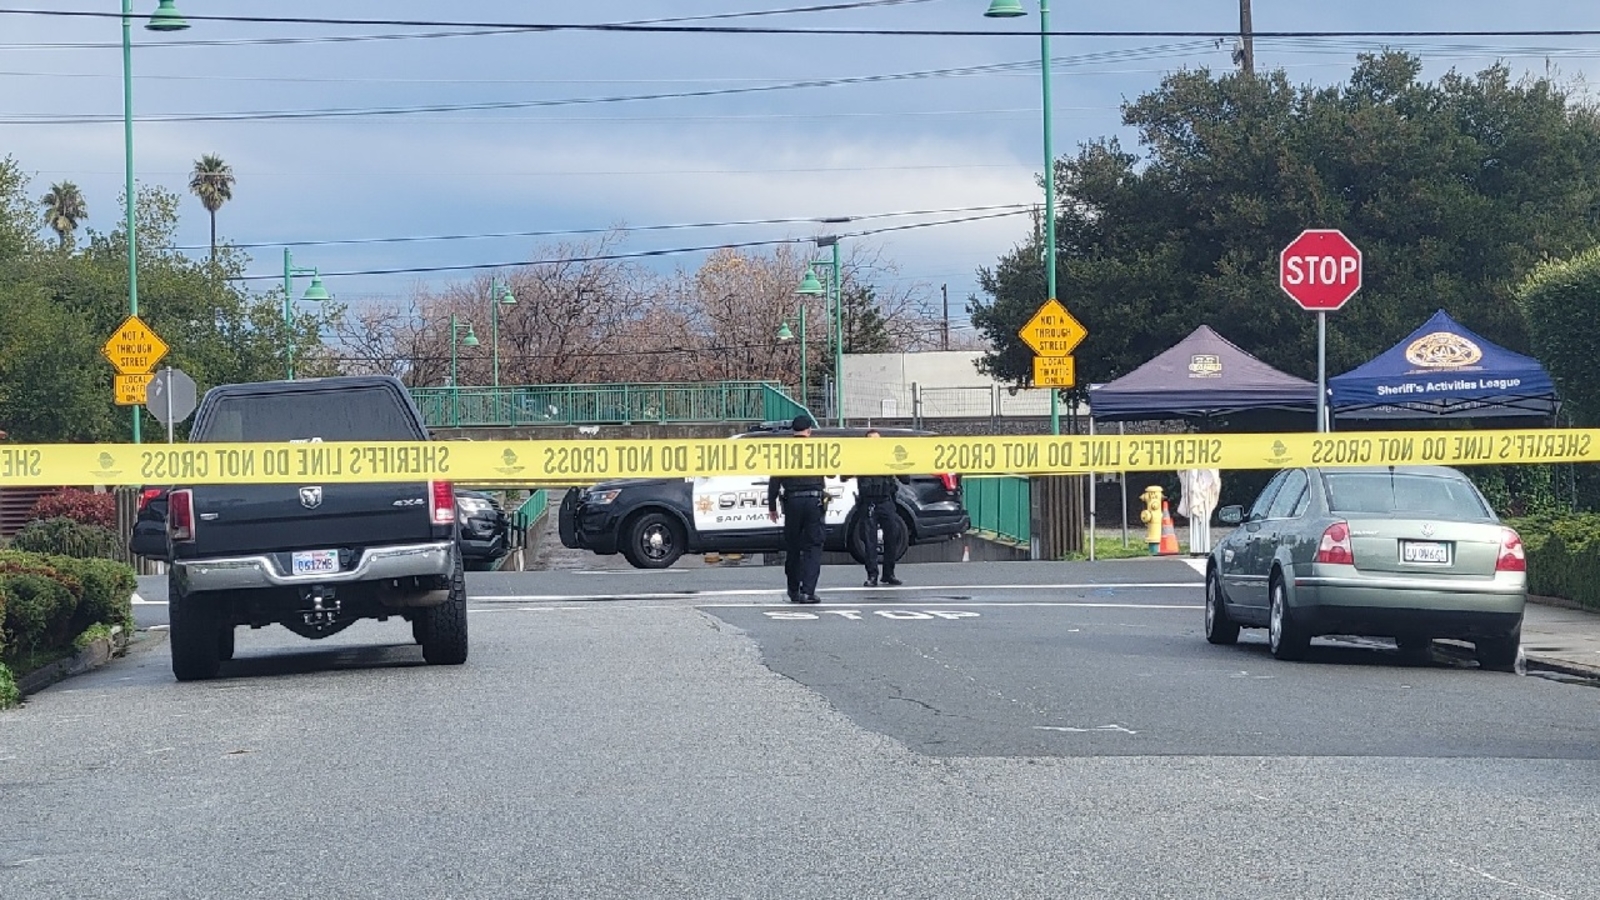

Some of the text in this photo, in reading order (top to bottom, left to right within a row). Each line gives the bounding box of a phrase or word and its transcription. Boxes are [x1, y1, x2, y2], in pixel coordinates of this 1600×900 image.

[1286, 256, 1357, 285] STOP
[1040, 315, 1065, 325] NOT A
[122, 331, 146, 341] NOT A
[1035, 328, 1071, 338] THROUGH
[116, 344, 152, 354] THROUGH
[1039, 341, 1067, 350] STREET
[120, 357, 148, 367] STREET
[1042, 358, 1066, 366] LOCAL
[124, 376, 147, 384] LOCAL
[121, 385, 146, 393] TRAFFI
[1376, 378, 1521, 396] Sheriff's Activities League
[125, 394, 146, 402] ONLY
[716, 515, 742, 523] SAN
[762, 609, 981, 620] STOP
